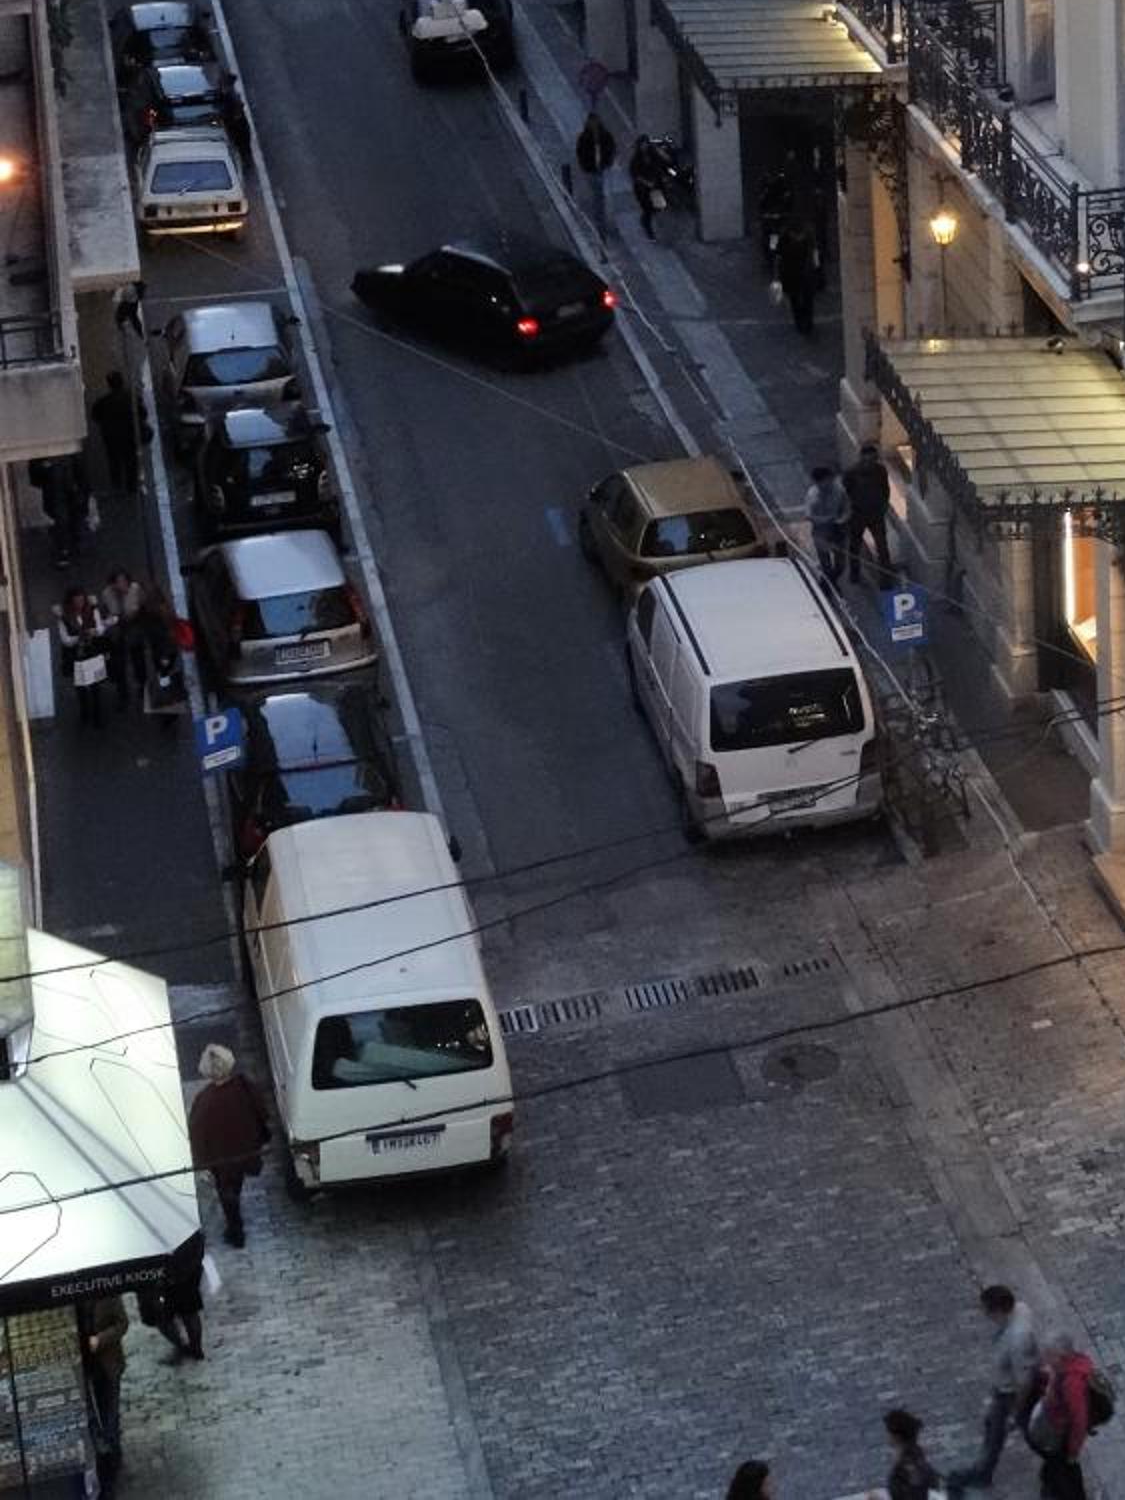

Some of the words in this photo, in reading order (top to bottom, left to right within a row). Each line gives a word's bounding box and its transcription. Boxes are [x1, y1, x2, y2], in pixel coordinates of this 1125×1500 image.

[894, 593, 915, 621] P
[205, 715, 228, 745] P
[51, 1274, 123, 1298] EXECUTIVE
[125, 1267, 167, 1284] KIOSK
